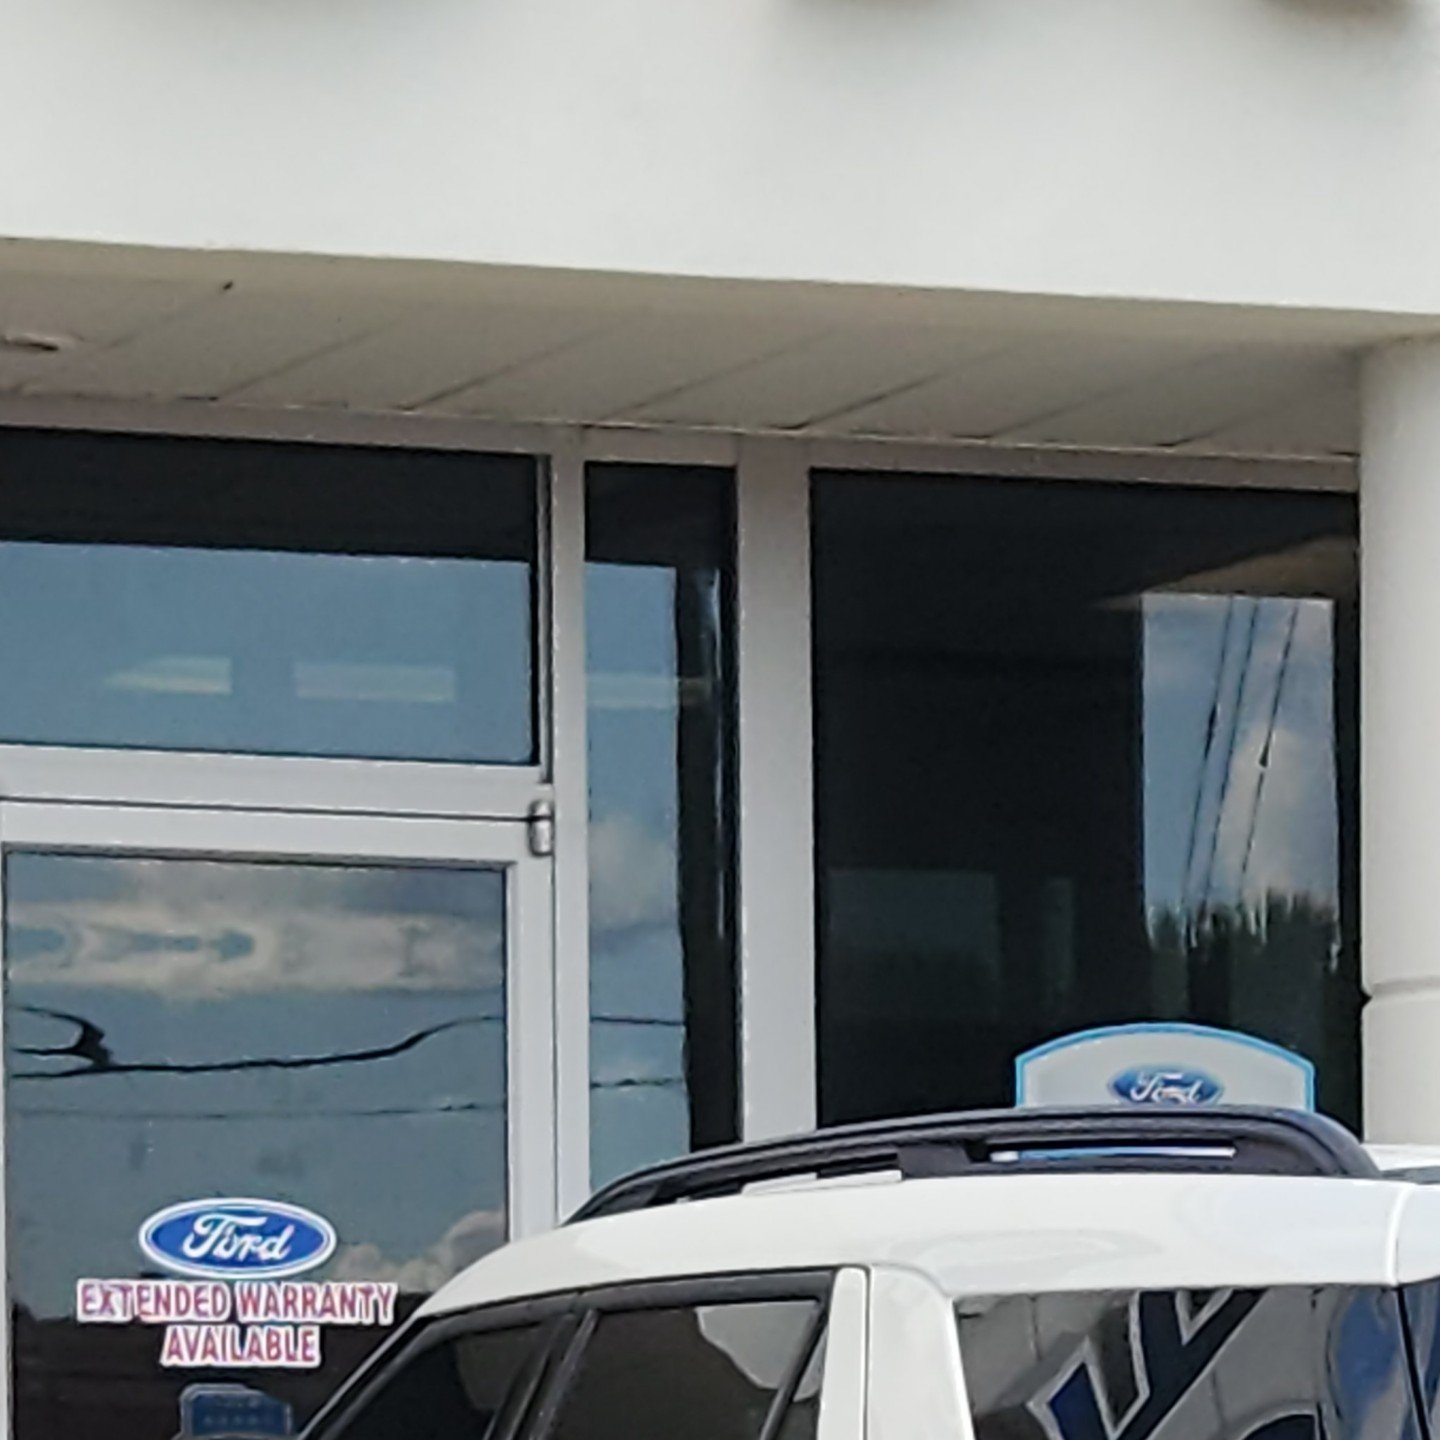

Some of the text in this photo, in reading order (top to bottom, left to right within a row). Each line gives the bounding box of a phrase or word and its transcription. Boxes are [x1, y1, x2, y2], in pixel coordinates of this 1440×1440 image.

[182, 1212, 295, 1262] Ford
[79, 1281, 394, 1321] EXTENDED WARRANTY
[164, 1327, 317, 1363] AVAILABLE
